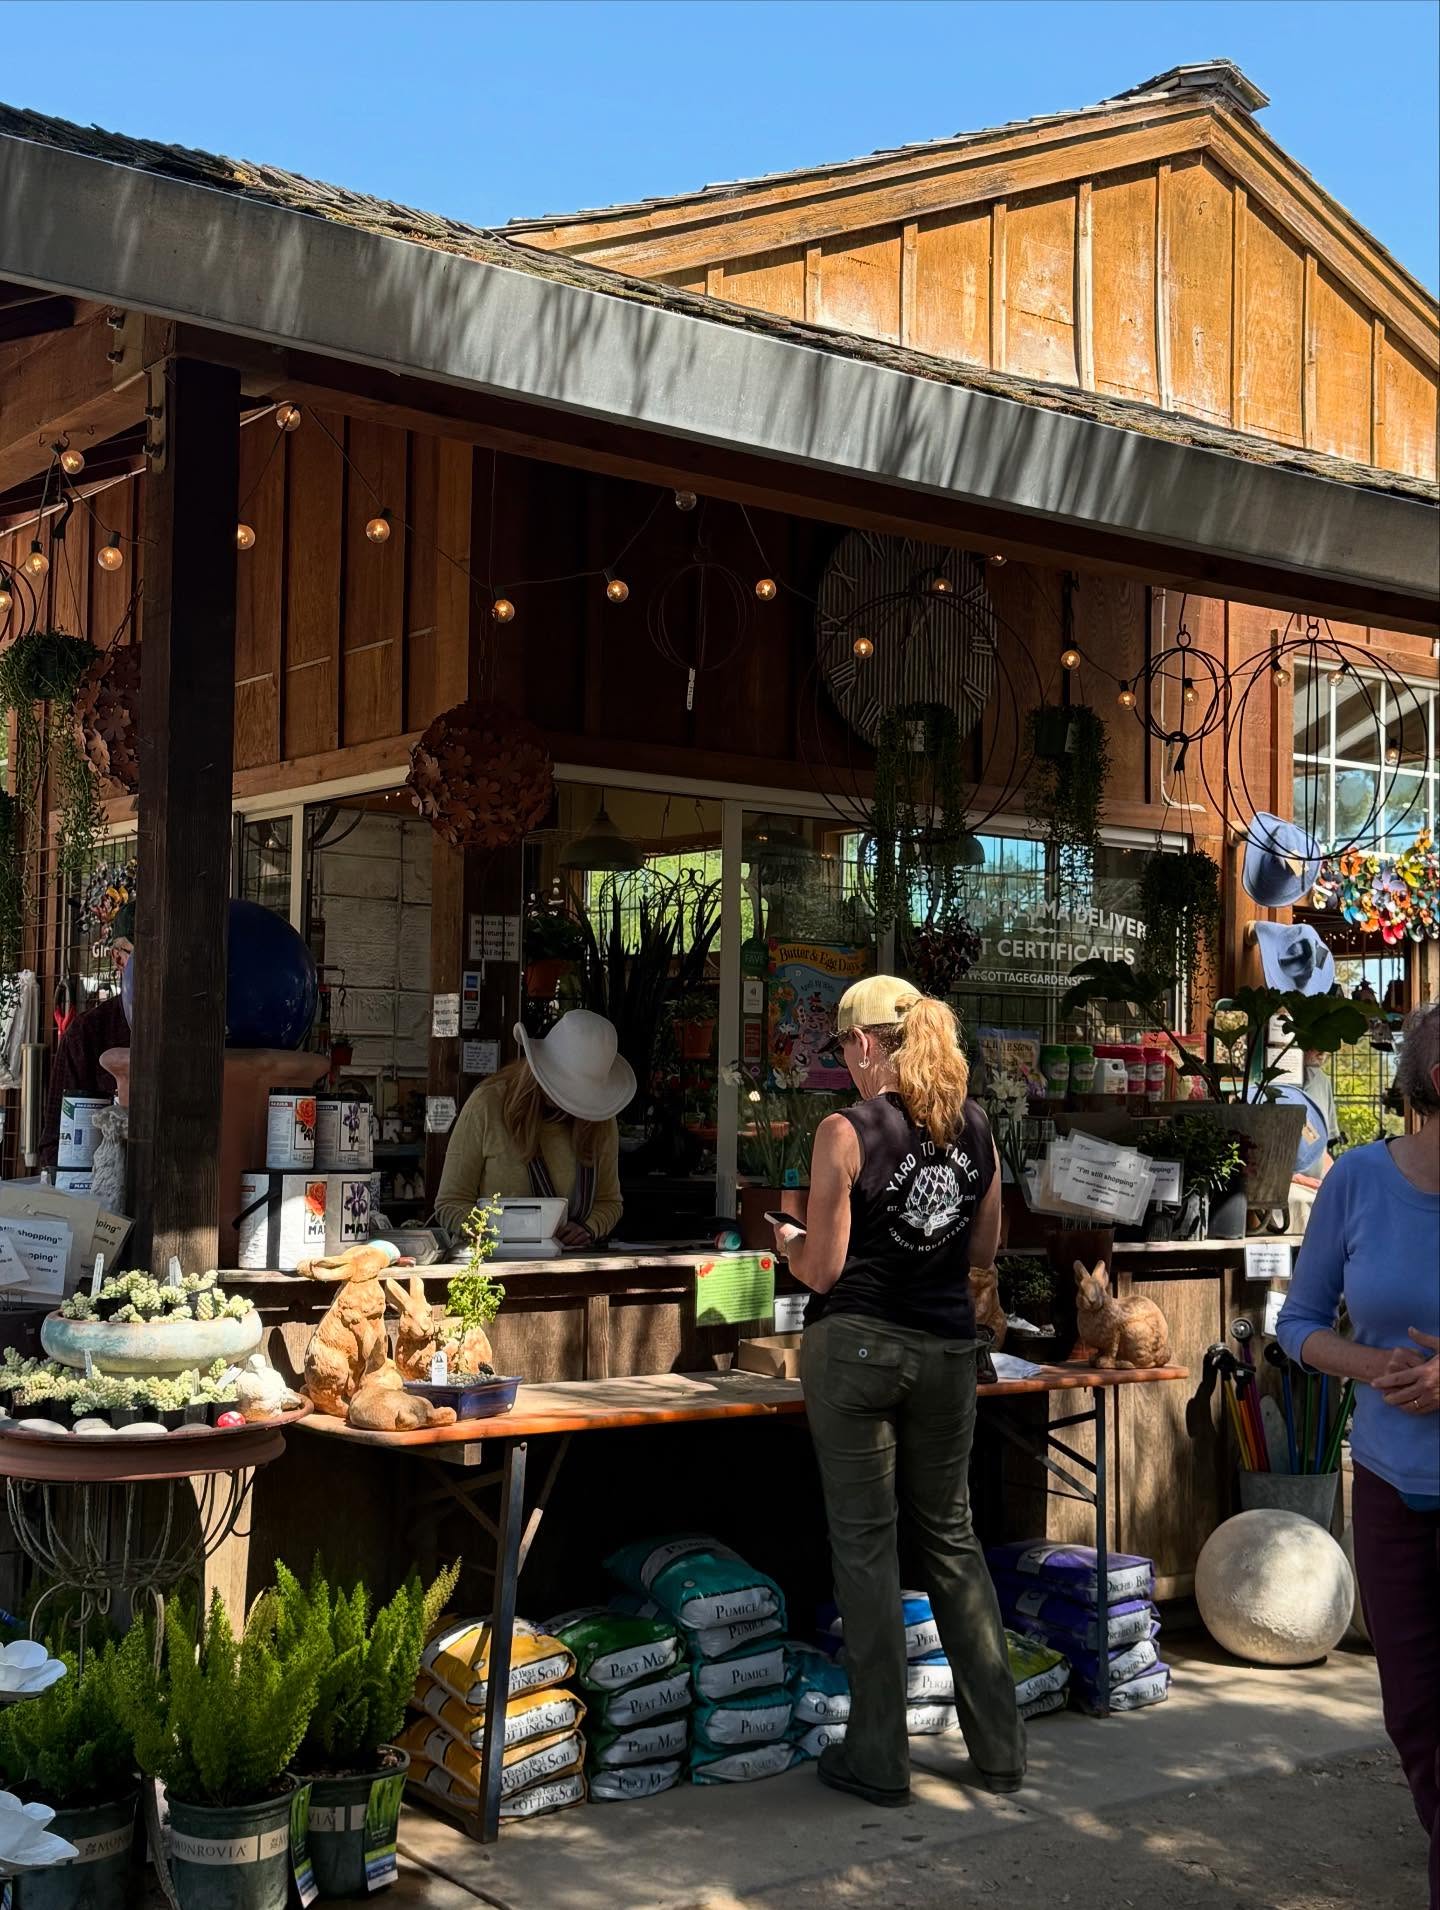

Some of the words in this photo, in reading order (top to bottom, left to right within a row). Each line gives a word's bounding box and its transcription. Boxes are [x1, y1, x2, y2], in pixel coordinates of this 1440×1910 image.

[780, 947, 808, 961] Butter
[810, 952, 819, 961] &
[820, 952, 838, 970] Egg
[997, 938, 1135, 965] CERTIFICATES
[886, 1153, 916, 1192] YARD
[920, 1141, 935, 1157] TO
[945, 1143, 979, 1182] TABLE
[1091, 1170, 1104, 1178] still
[610, 1662, 639, 1678] PEAT
[731, 1667, 769, 1684] PUMICE
[630, 1699, 655, 1714] PEAT
[741, 1719, 776, 1734] PUMICE
[547, 1751, 571, 1768] SOIL
